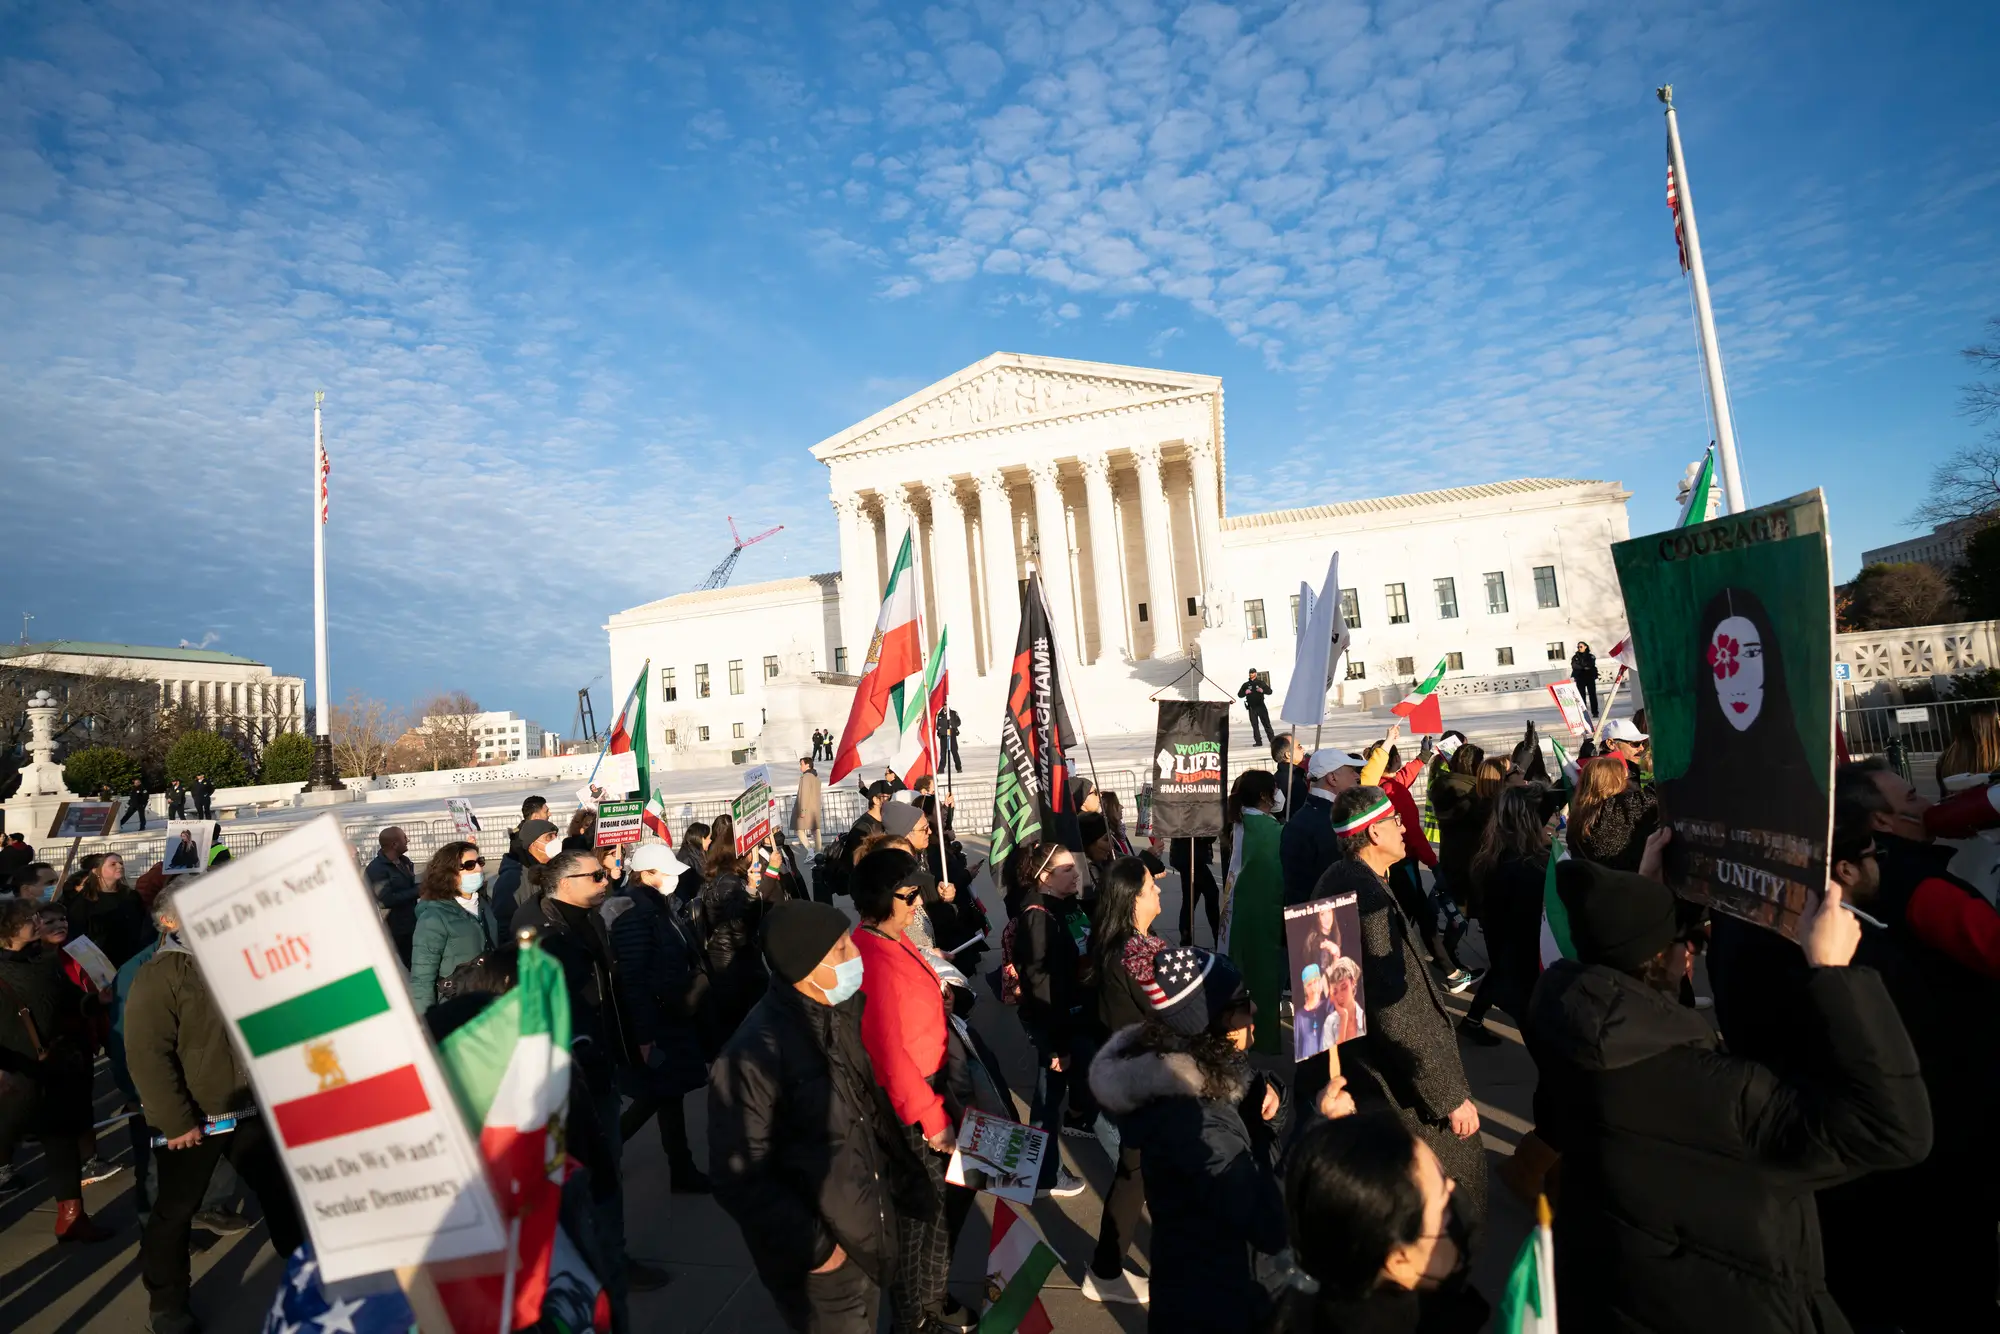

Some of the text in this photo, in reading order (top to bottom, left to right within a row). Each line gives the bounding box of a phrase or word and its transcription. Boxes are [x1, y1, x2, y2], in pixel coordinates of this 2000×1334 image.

[1174, 741, 1221, 755] WOMEN
[1174, 752, 1221, 774] LIFE
[1017, 755, 1044, 796] THE
[1175, 770, 1221, 784] FREEDOM
[1160, 784, 1221, 793] #MAHSAAMINI
[612, 805, 628, 813] STAND
[600, 818, 640, 829] REGIME CHANGE
[600, 831, 624, 839] DEMOCRACY
[1716, 858, 1785, 903] UNITY
[1307, 905, 1313, 915] is
[241, 932, 312, 981] Unity
[1003, 1127, 1025, 1169] IRAN
[1026, 1134, 1042, 1165] UNITY
